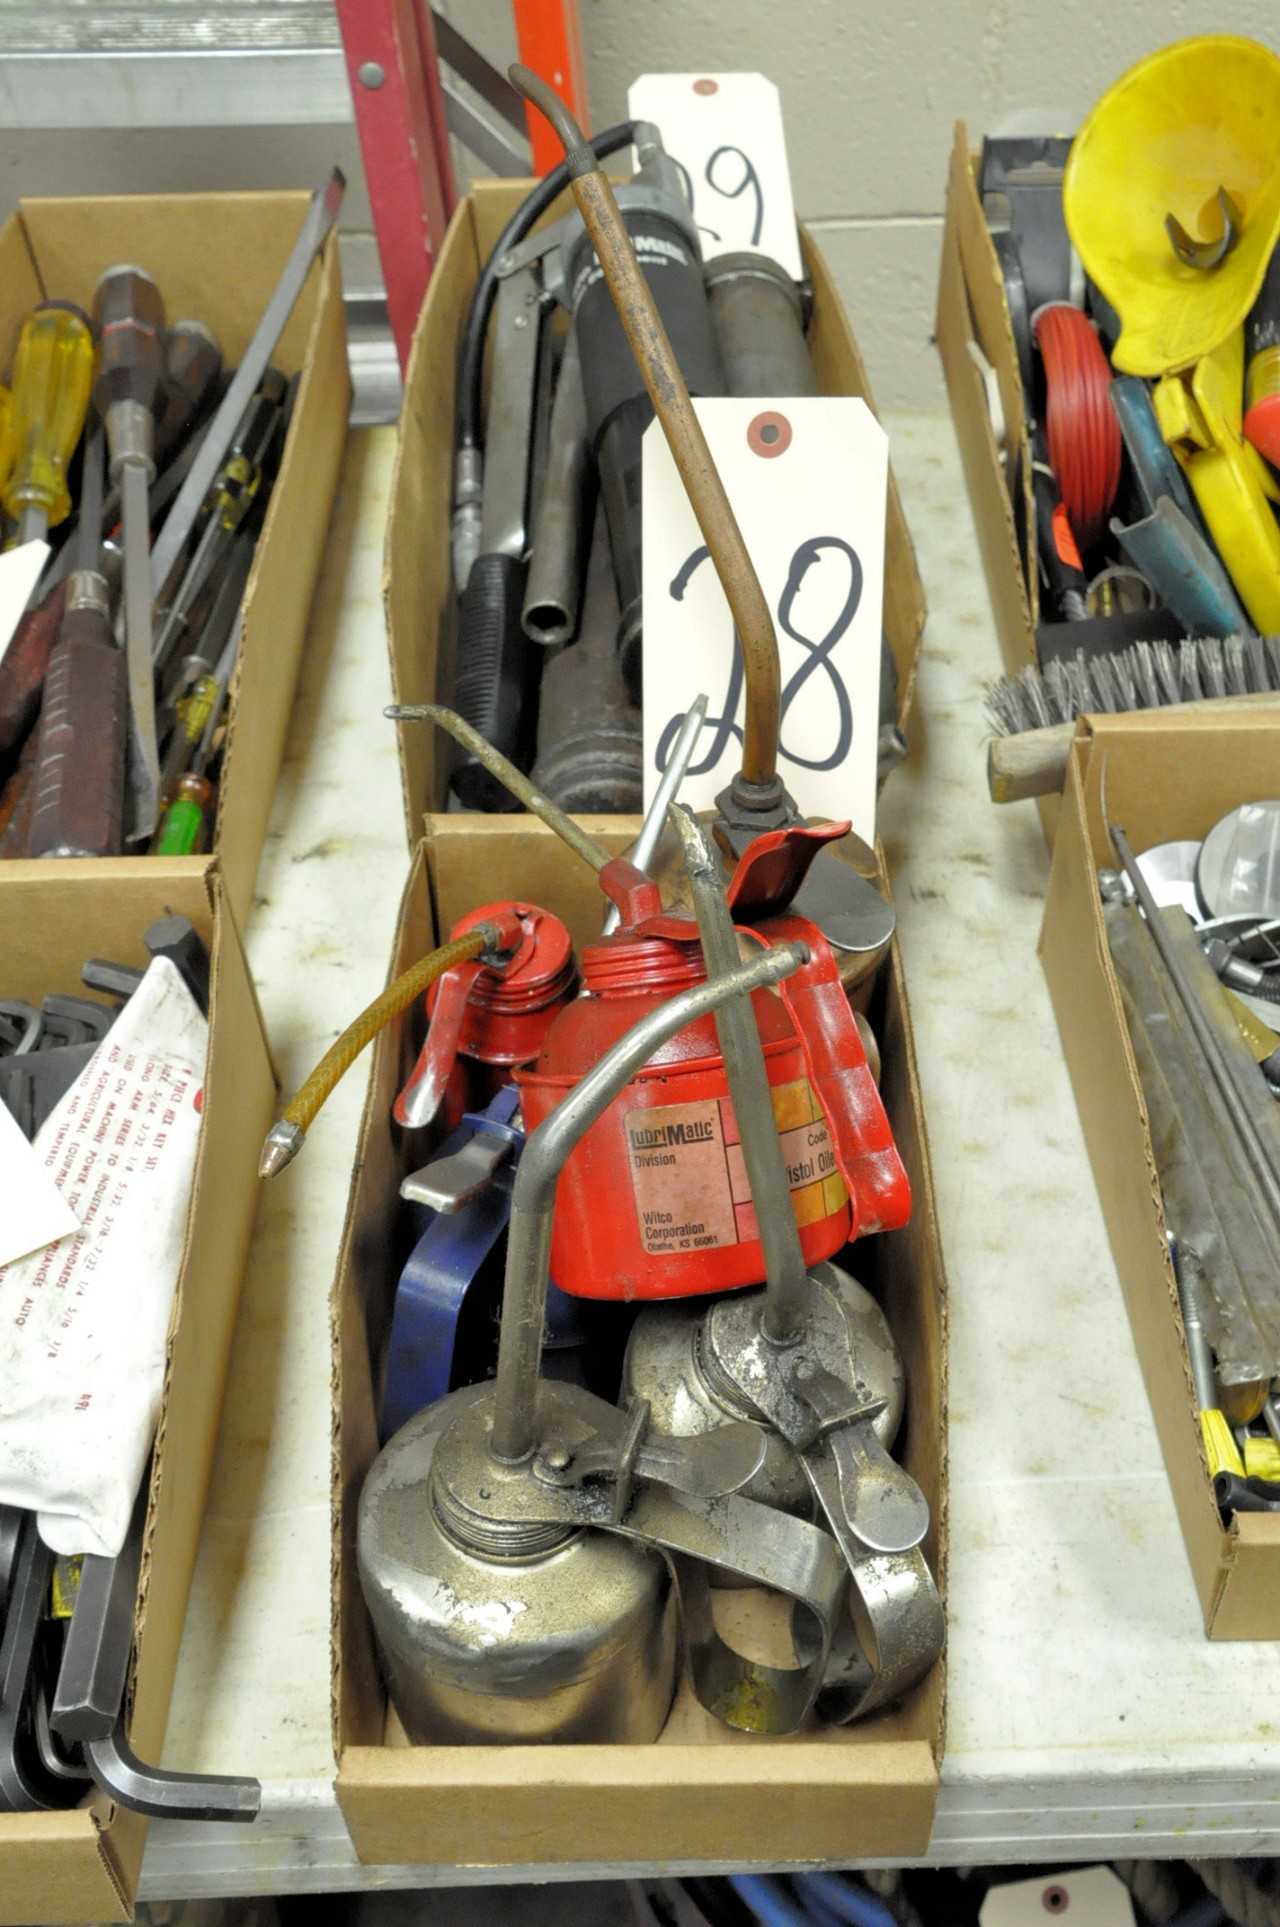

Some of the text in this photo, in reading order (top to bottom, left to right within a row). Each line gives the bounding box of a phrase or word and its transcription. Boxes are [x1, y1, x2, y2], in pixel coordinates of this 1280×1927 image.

[655, 536, 863, 776] 28
[114, 1078, 127, 1094] ON
[66, 1095, 81, 1115] AND
[129, 1089, 144, 1111] ARM
[53, 1044, 122, 1192] AND AGRICULTURAL EQUIPMEN
[115, 1118, 133, 1147] SERIES
[629, 1121, 714, 1150] LubriMatic
[107, 1153, 120, 1167] TO
[634, 1154, 676, 1168] Division
[785, 1157, 815, 1185] istol
[81, 1173, 111, 1226] INDUSTRIAL
[642, 1212, 673, 1226] Witco
[645, 1223, 705, 1240] Corporation
[679, 1239, 690, 1248] KS
[55, 1232, 86, 1289] STANDARDS
[15, 1297, 34, 1327] AUTO
